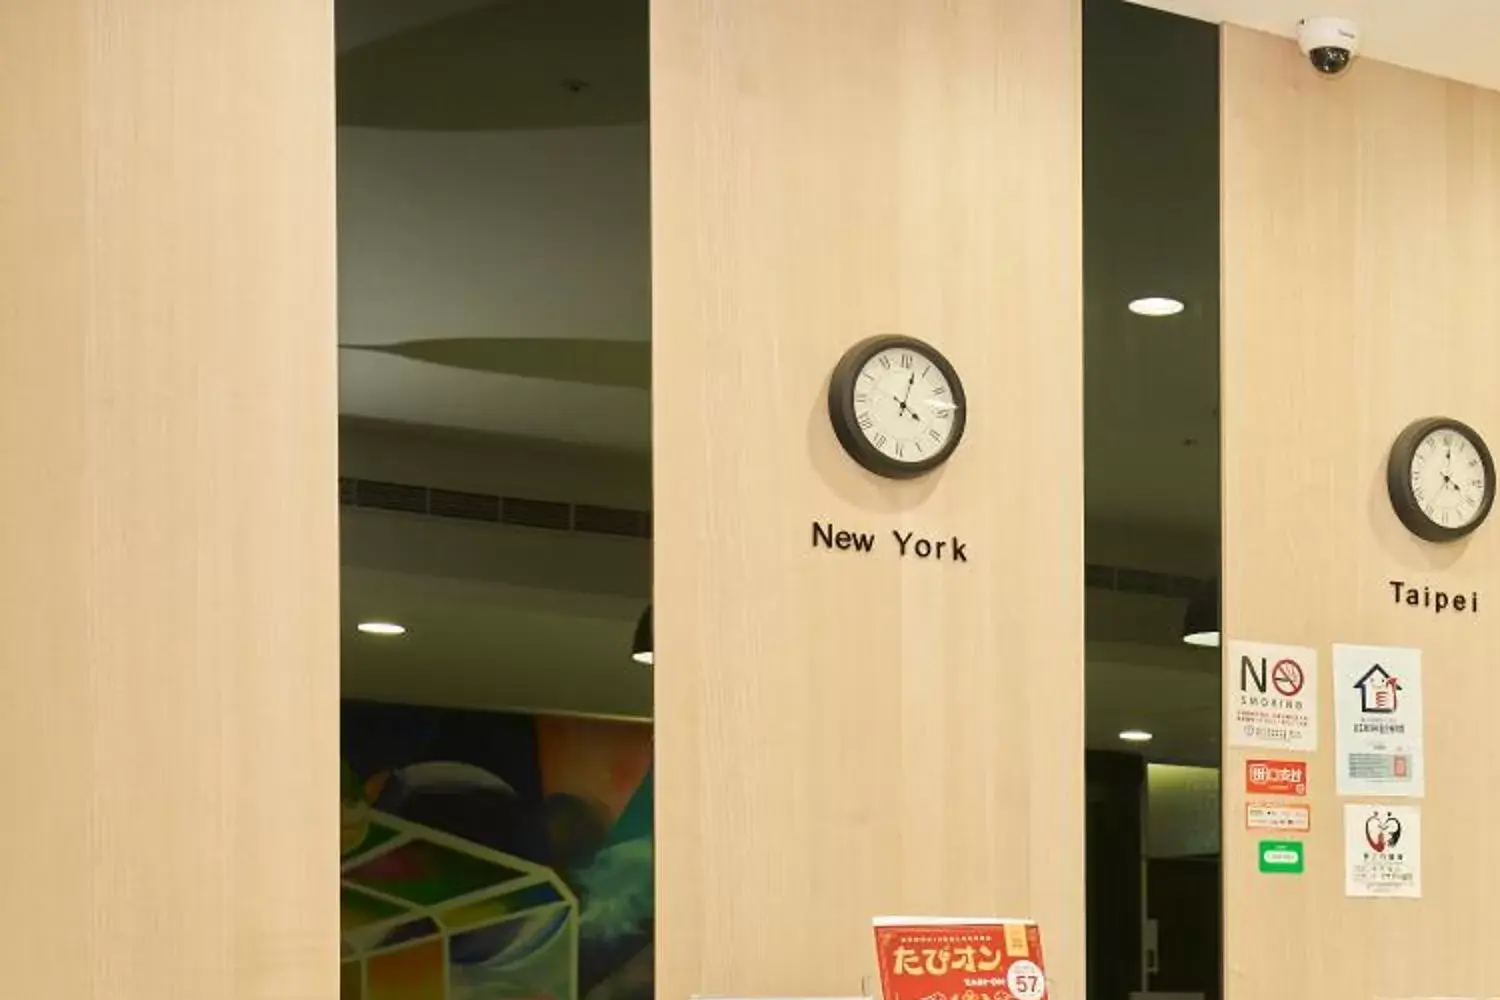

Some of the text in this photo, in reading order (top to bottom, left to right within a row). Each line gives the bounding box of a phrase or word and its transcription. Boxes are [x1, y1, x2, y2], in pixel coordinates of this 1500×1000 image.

[812, 521, 967, 562] New York
[1389, 581, 1477, 613] Taipei
[893, 945, 1002, 975] たびオン
[1016, 975, 1038, 993] 57
